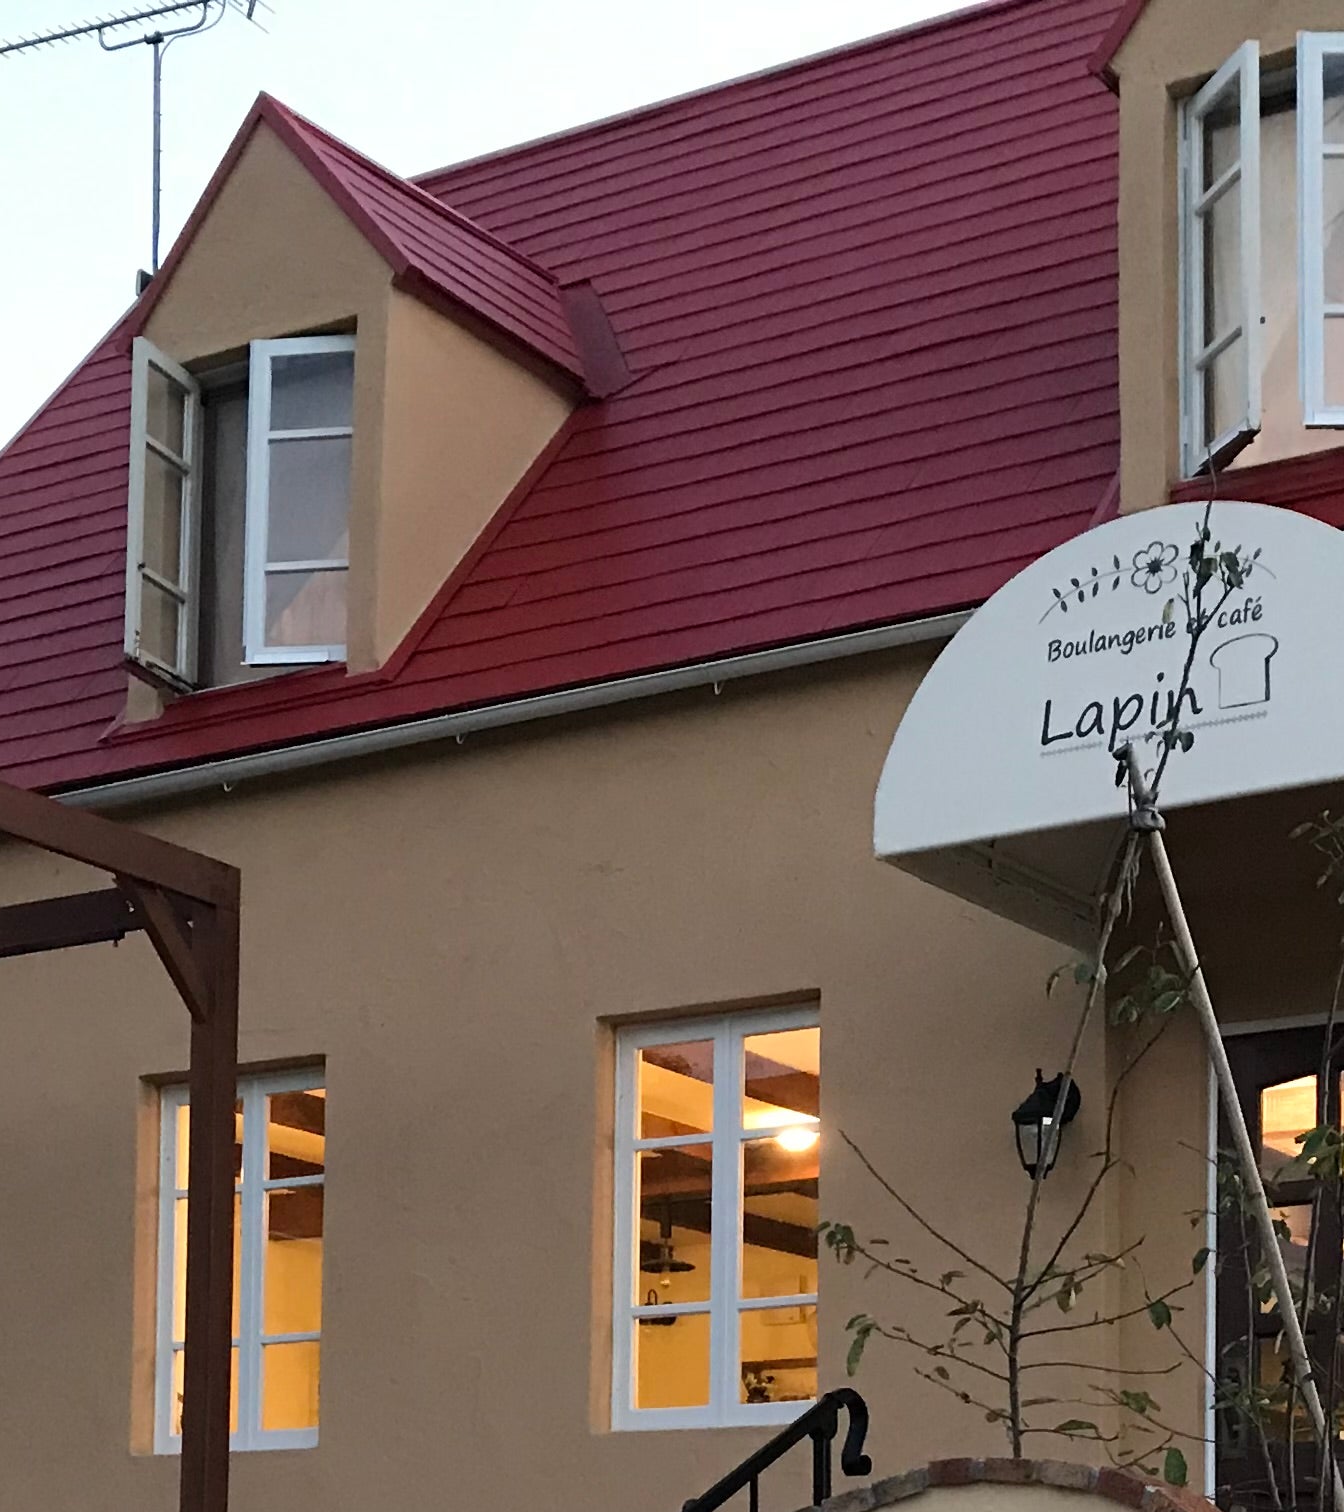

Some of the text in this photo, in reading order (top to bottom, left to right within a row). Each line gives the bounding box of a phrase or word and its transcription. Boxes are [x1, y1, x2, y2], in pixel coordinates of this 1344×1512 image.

[1047, 620, 1176, 662] Boulangerie
[1217, 596, 1263, 629] café
[1041, 672, 1203, 753] Lapin
